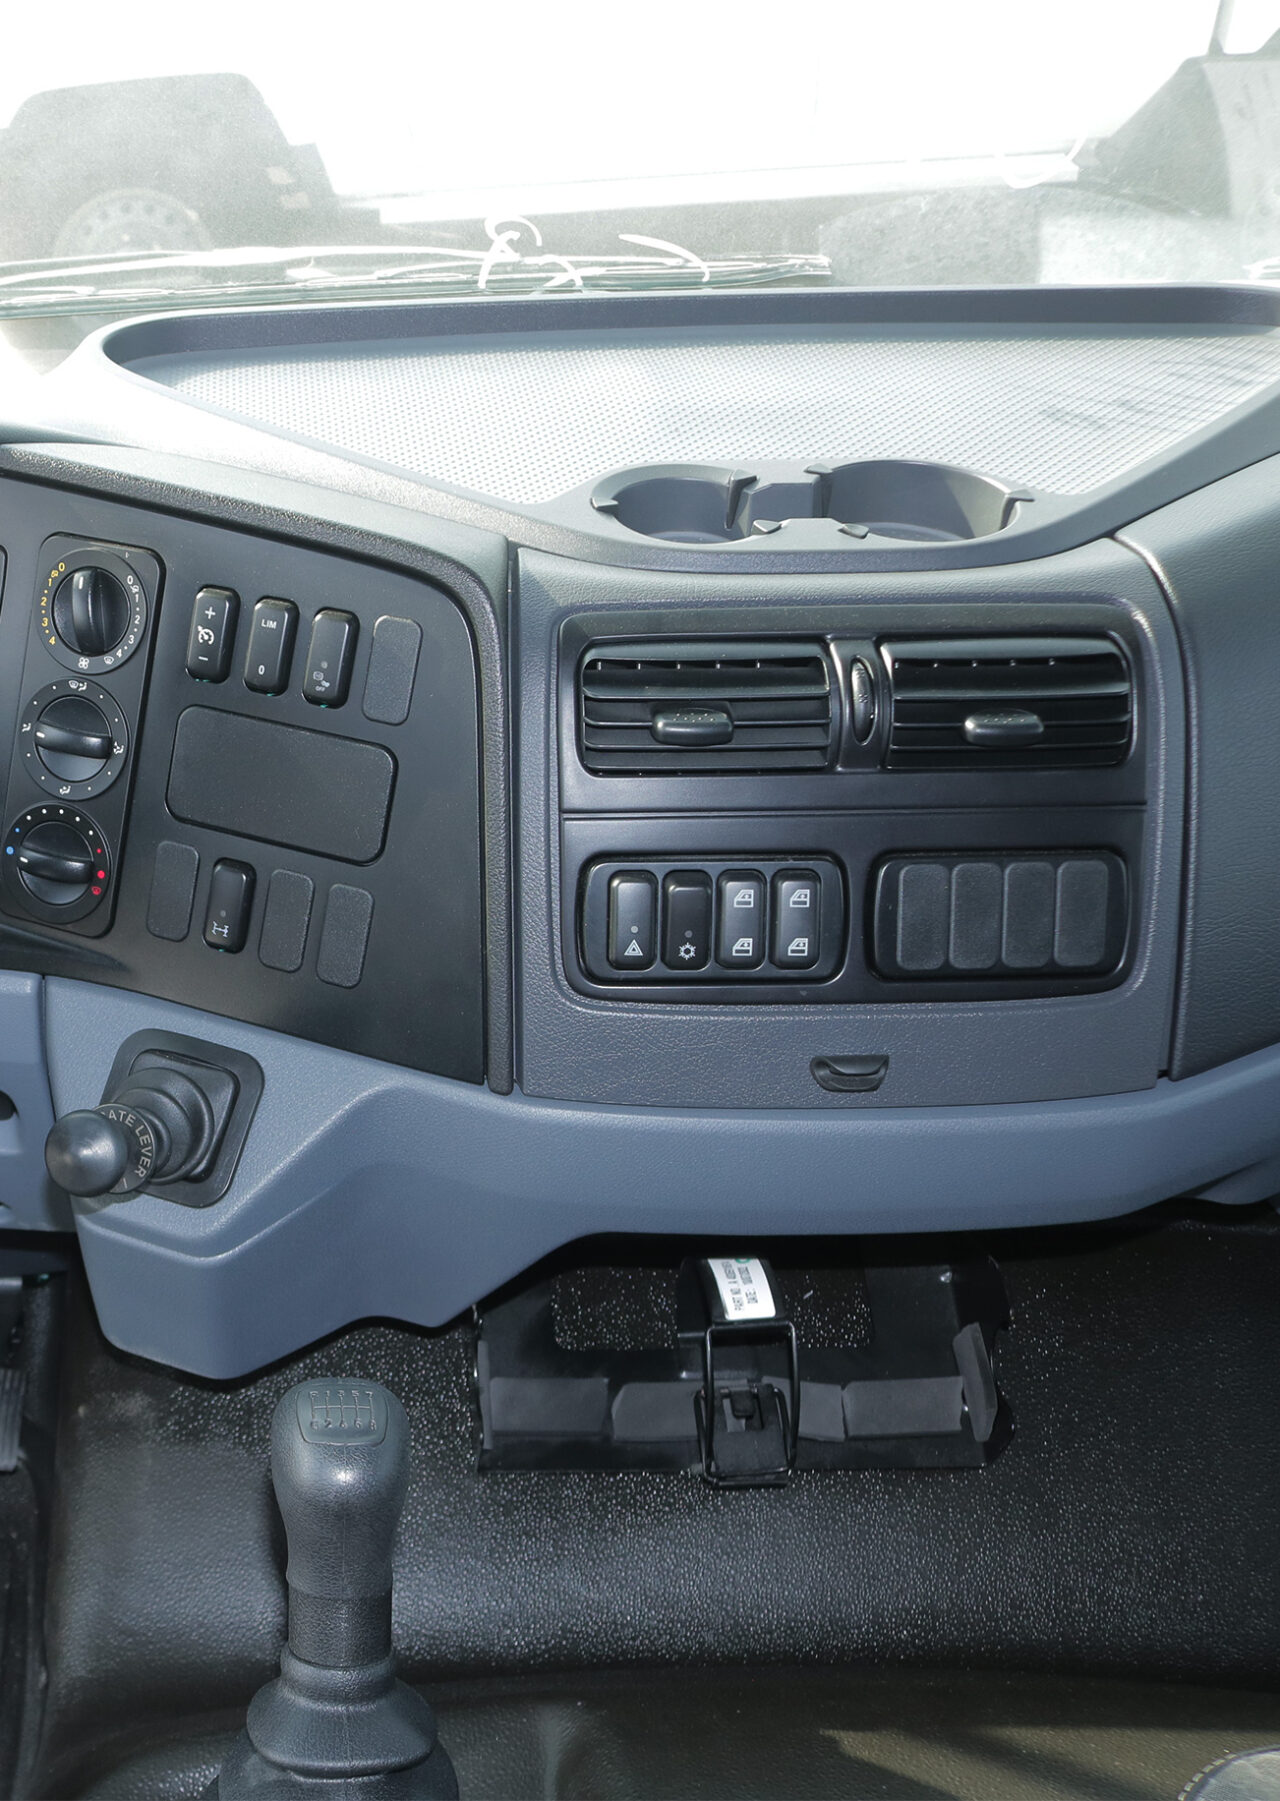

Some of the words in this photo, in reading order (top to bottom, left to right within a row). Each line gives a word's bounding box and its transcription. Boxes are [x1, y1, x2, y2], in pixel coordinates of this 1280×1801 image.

[58, 562, 66, 572] 0
[47, 578, 52, 587] 1
[127, 575, 133, 585] 0
[41, 597, 47, 606] 2
[134, 593, 139, 603] 1
[41, 617, 49, 627] 3
[134, 615, 141, 625] 2
[261, 618, 278, 630] LIM
[49, 636, 56, 646] 4
[128, 635, 135, 645] 3
[116, 648, 123, 658] 4
[258, 665, 265, 675] 0
[134, 1124, 154, 1179] LEVER
